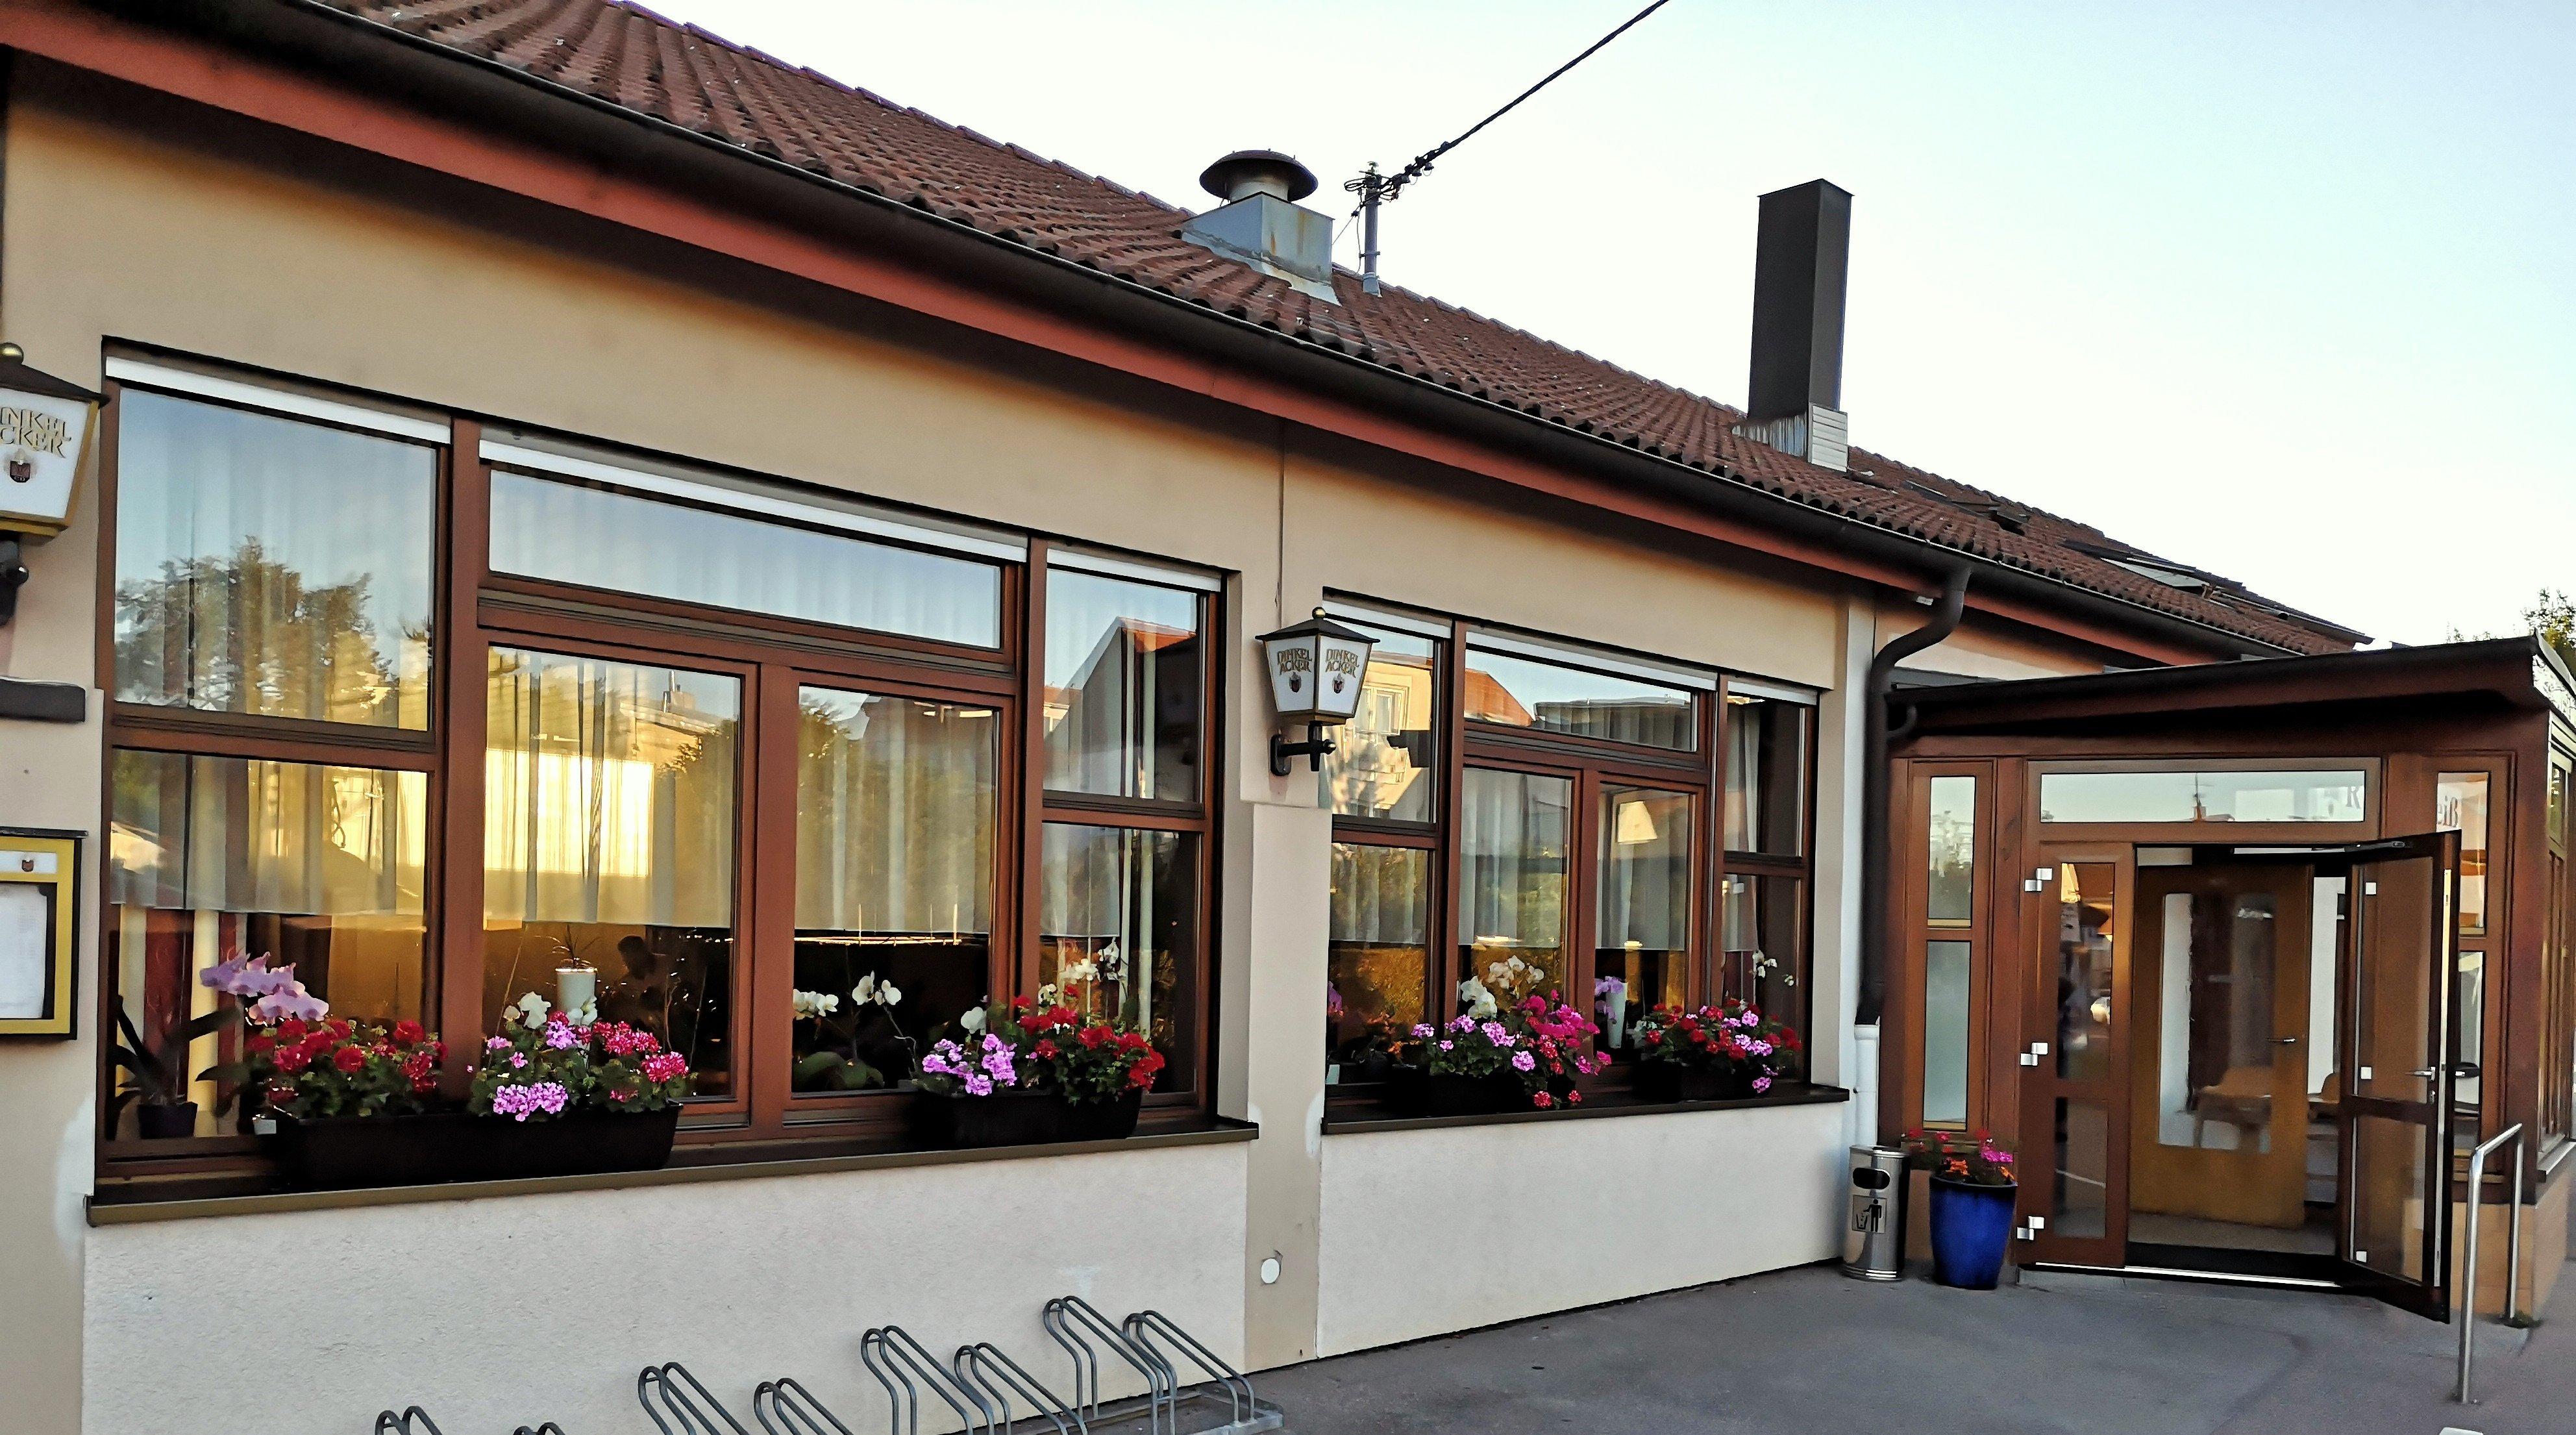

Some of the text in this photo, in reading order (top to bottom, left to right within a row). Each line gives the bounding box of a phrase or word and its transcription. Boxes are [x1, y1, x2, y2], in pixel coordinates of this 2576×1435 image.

[1277, 648, 1312, 664] DINKEL
[1326, 649, 1359, 668] DINKEL
[1279, 660, 1311, 675] ACKER
[1325, 661, 1356, 678] ACKER
